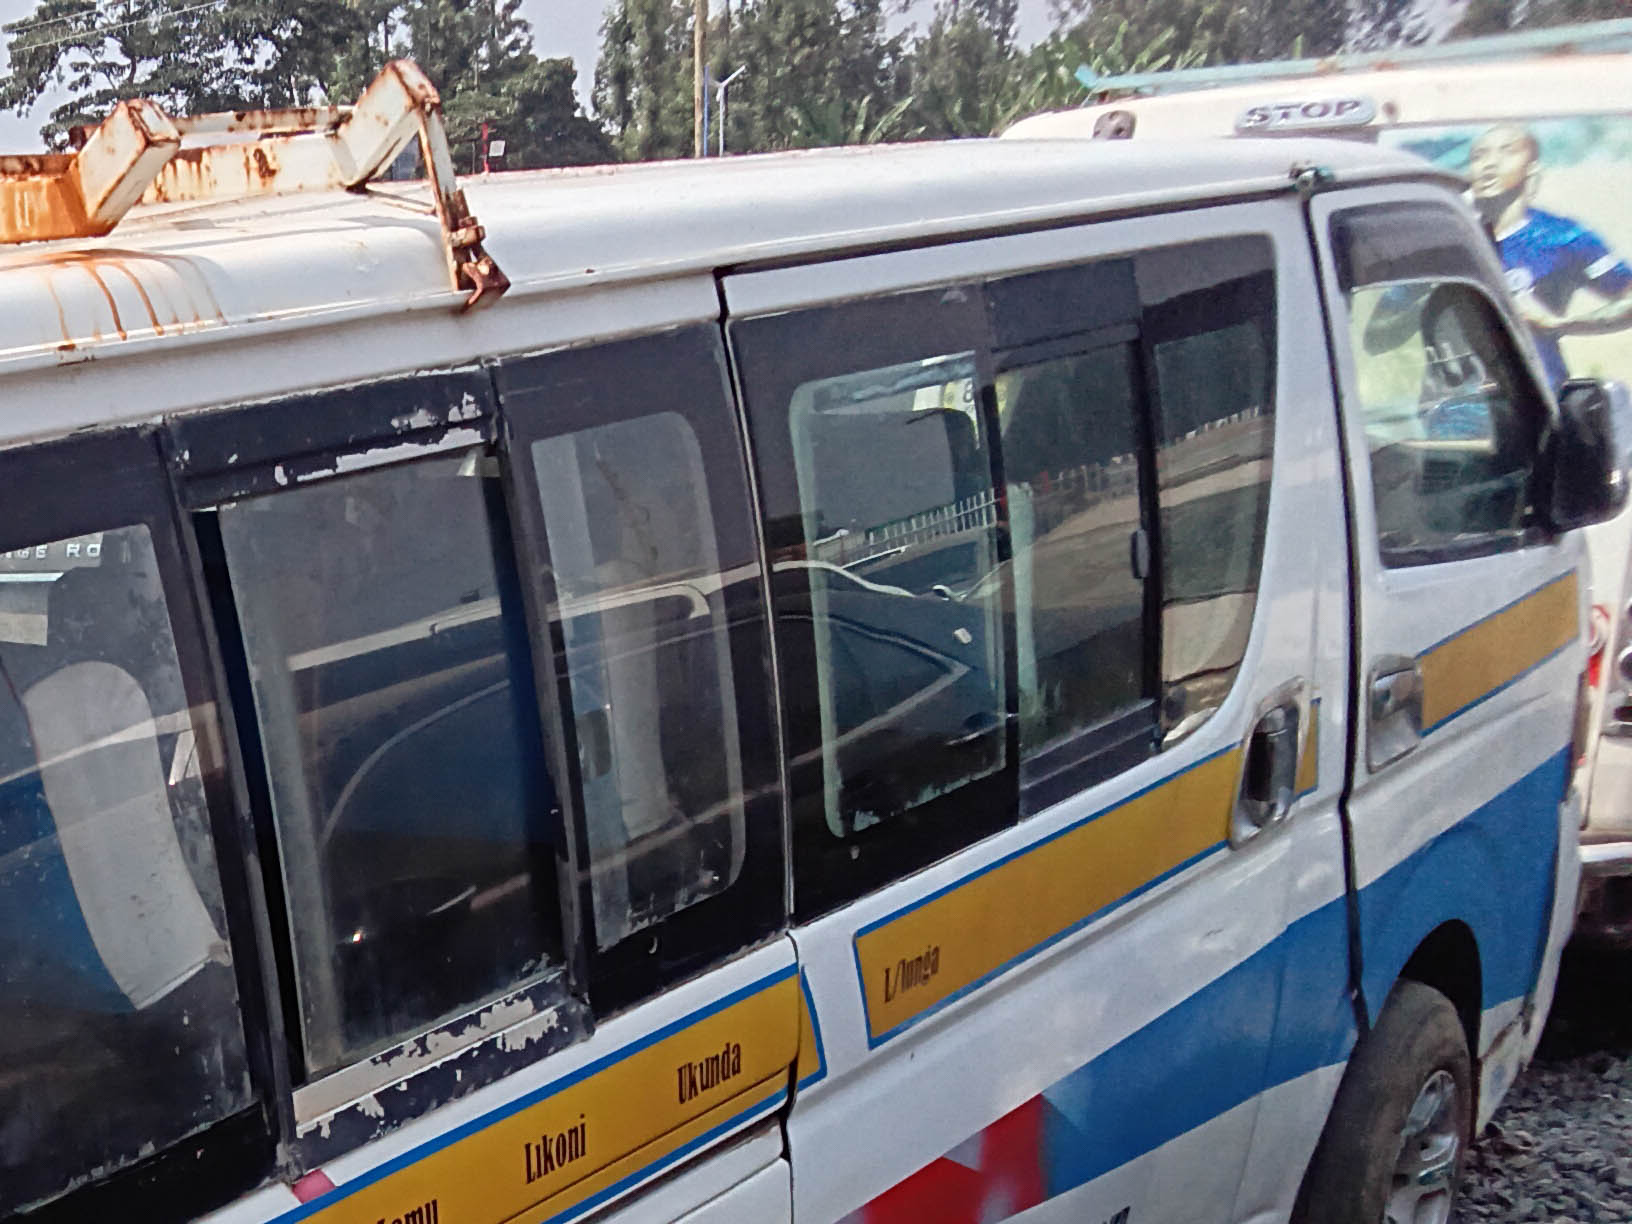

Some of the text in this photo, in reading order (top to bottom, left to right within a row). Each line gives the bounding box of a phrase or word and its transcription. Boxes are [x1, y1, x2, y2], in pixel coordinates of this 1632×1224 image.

[1246, 100, 1360, 124] STOP
[525, 1114, 587, 1184] Likoni
[677, 1041, 741, 1105] Ukunda
